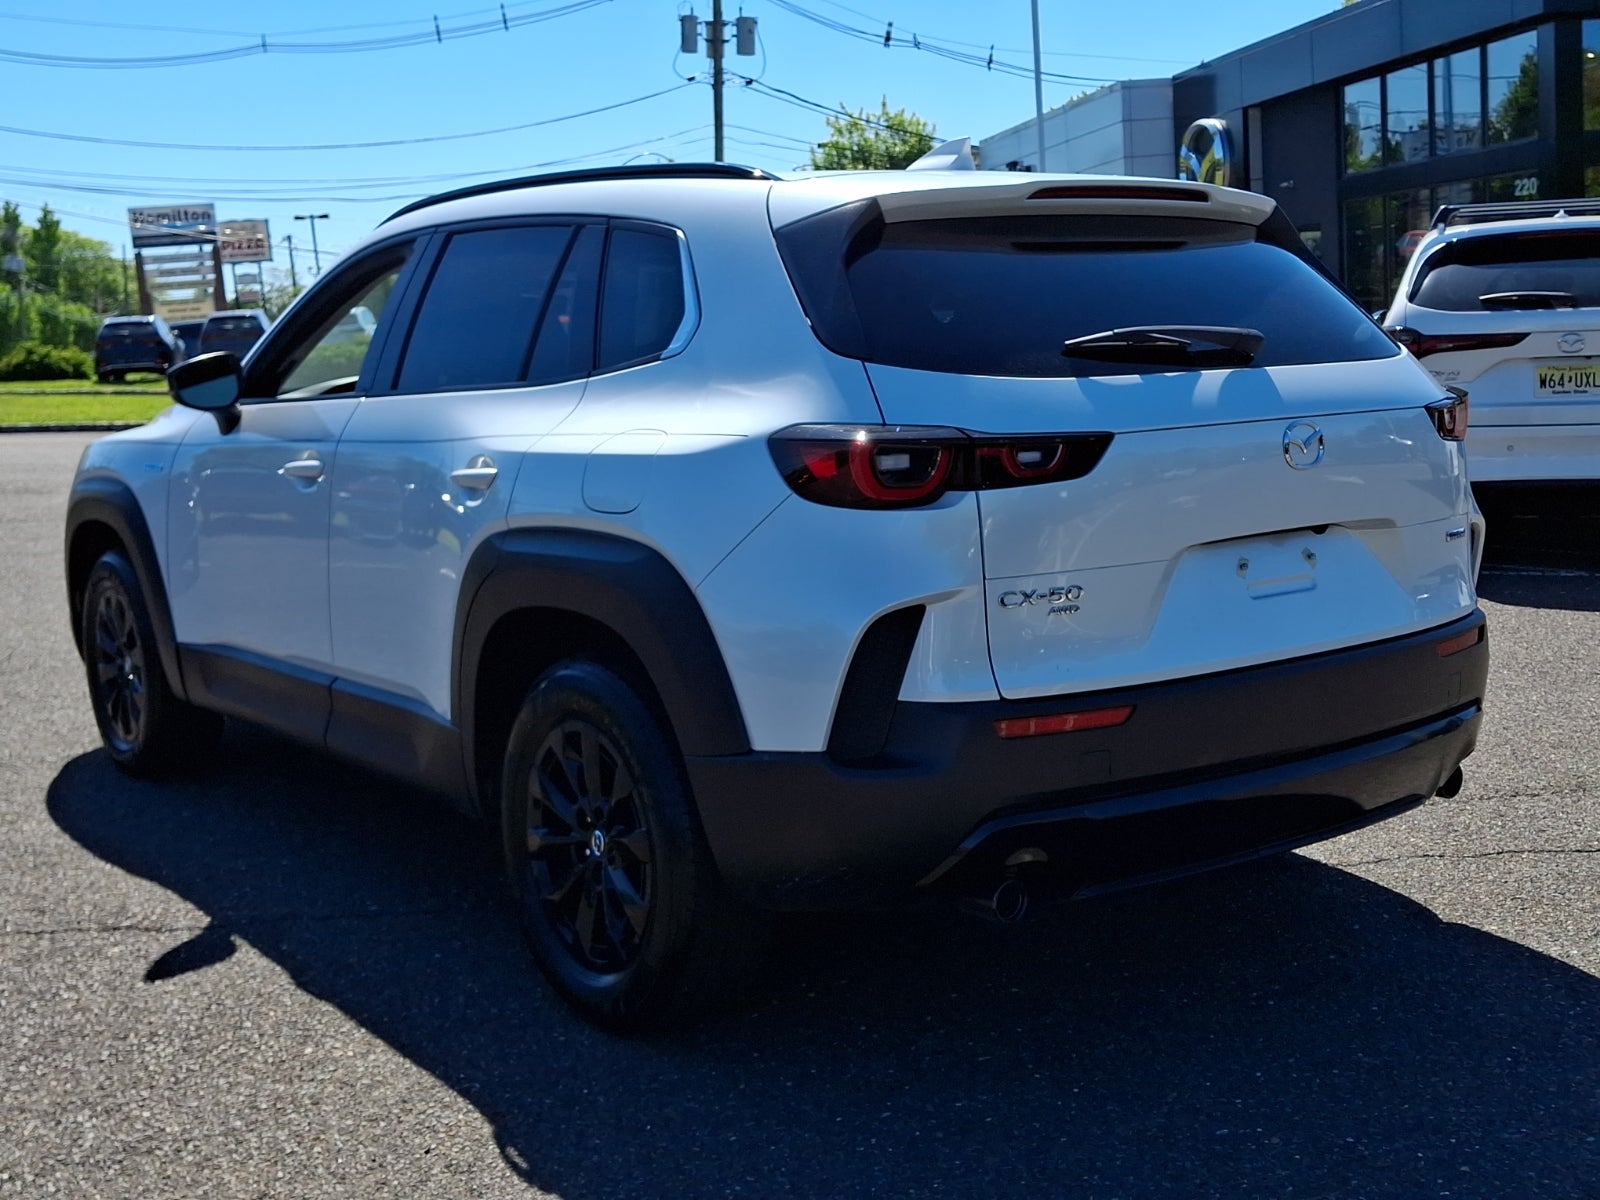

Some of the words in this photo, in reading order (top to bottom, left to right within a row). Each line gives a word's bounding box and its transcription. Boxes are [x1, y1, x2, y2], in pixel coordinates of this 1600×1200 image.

[1514, 177, 1538, 197] 220
[998, 584, 1084, 609] CX-50
[1048, 604, 1081, 616] AWD
